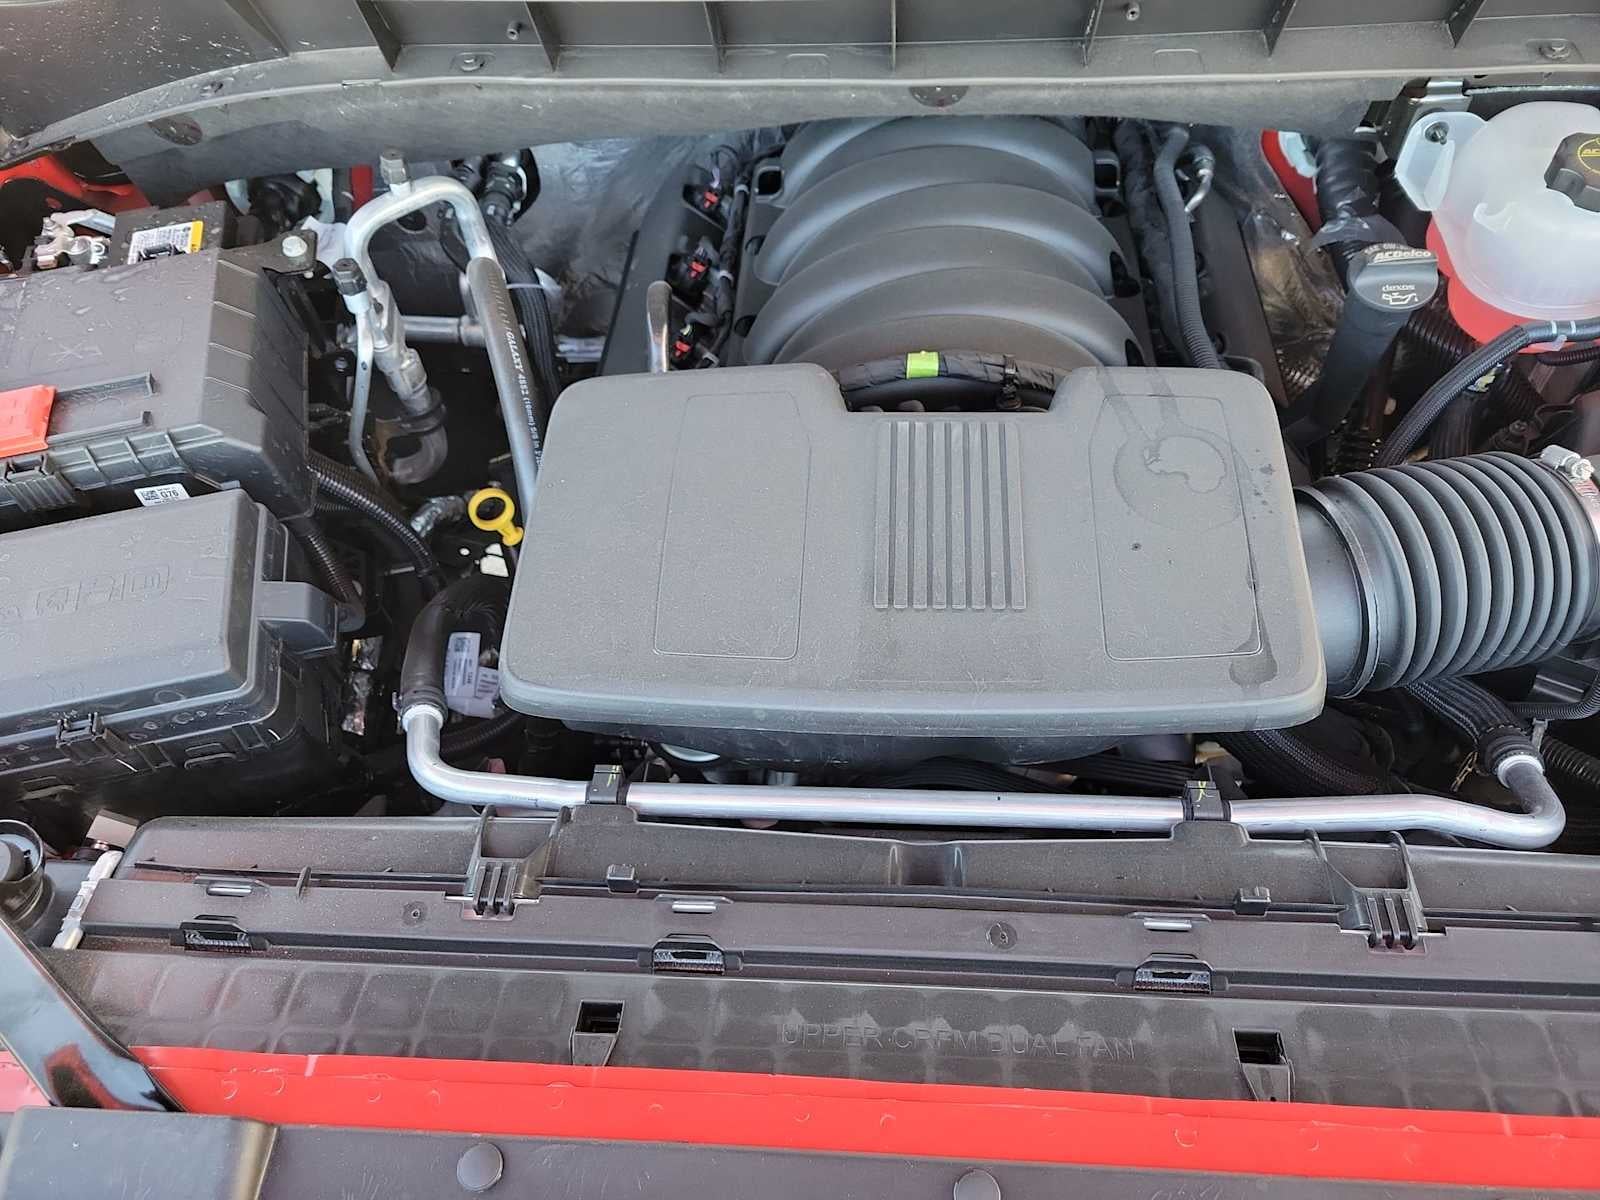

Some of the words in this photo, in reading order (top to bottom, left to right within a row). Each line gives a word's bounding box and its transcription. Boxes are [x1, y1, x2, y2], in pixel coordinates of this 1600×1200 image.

[1374, 249, 1432, 263] ACDelco
[1382, 284, 1415, 292] dexos
[506, 331, 525, 373] GALAXY
[160, 489, 179, 498] G76
[778, 1023, 884, 1049] UPPER
[985, 1028, 1068, 1058] DUAL
[1076, 1032, 1135, 1061] FAN
